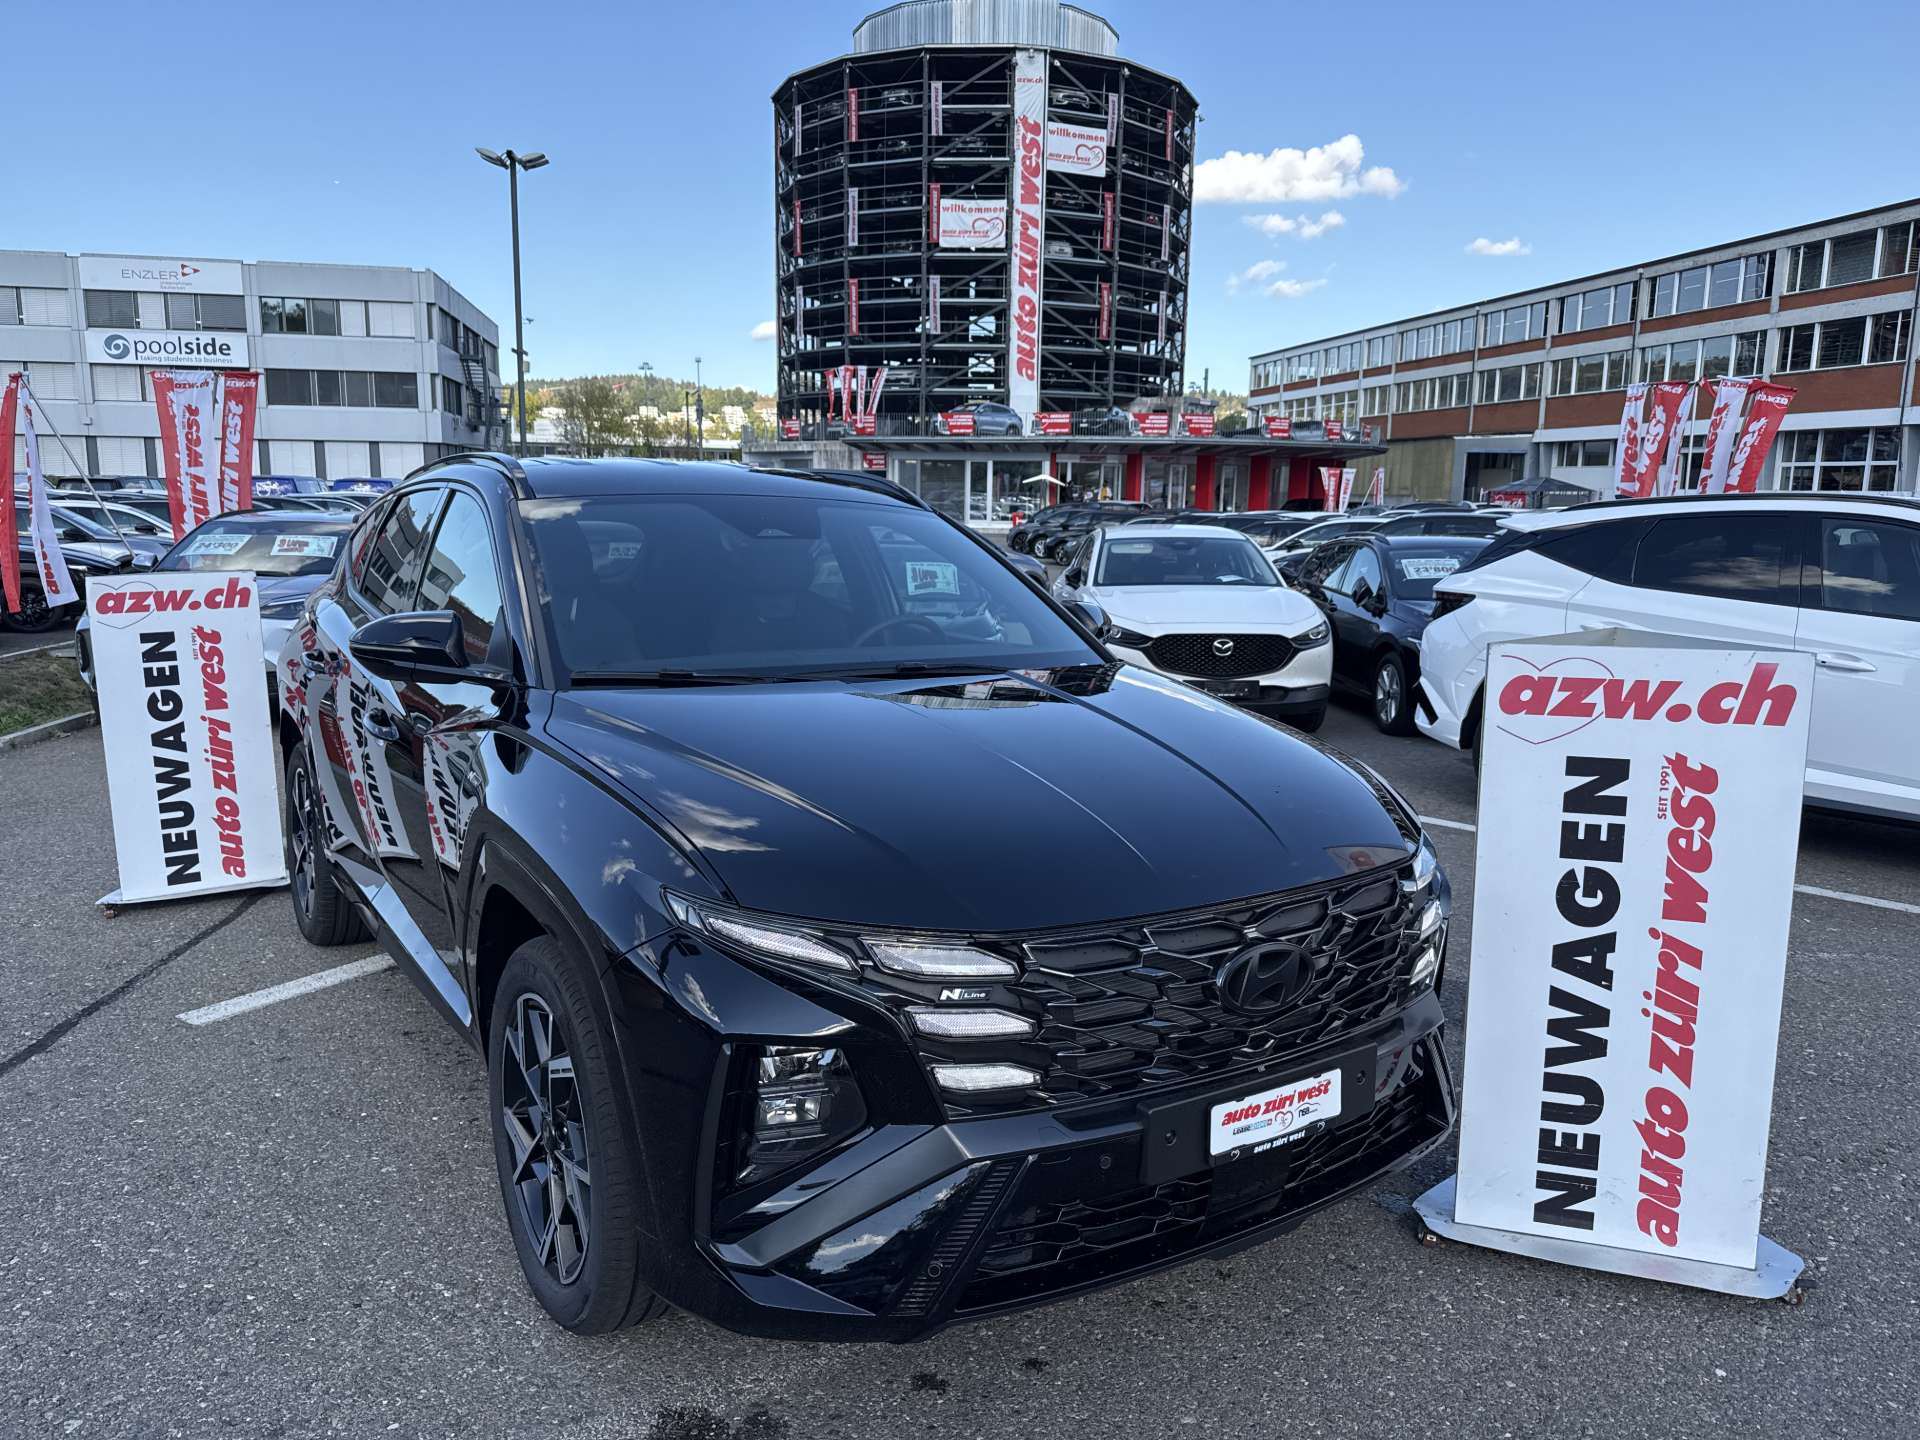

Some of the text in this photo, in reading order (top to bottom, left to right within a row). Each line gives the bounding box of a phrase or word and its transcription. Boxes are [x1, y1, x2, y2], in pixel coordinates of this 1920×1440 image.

[1048, 128, 1105, 142] willkommen
[942, 204, 1004, 213] willkommen
[122, 269, 179, 280] ENZLER
[1014, 115, 1042, 382] auto züri west
[134, 336, 231, 360] poolside
[163, 356, 194, 364] students
[185, 403, 203, 468] west
[224, 399, 243, 464] west
[1620, 415, 1640, 483] west
[96, 577, 251, 615] azw.ch
[1499, 663, 1798, 727] azw.ch
[139, 631, 202, 886] NEUWAGEN
[192, 625, 247, 878] auto züri west
[1657, 765, 1670, 820] SEIT 1991
[940, 988, 962, 1001] N
[1533, 756, 1631, 1231] NEUWAGEN
[1632, 752, 1719, 1248] auto züri west
[1222, 1079, 1331, 1126] auto züri west
[1253, 1130, 1306, 1154] auto züri west
